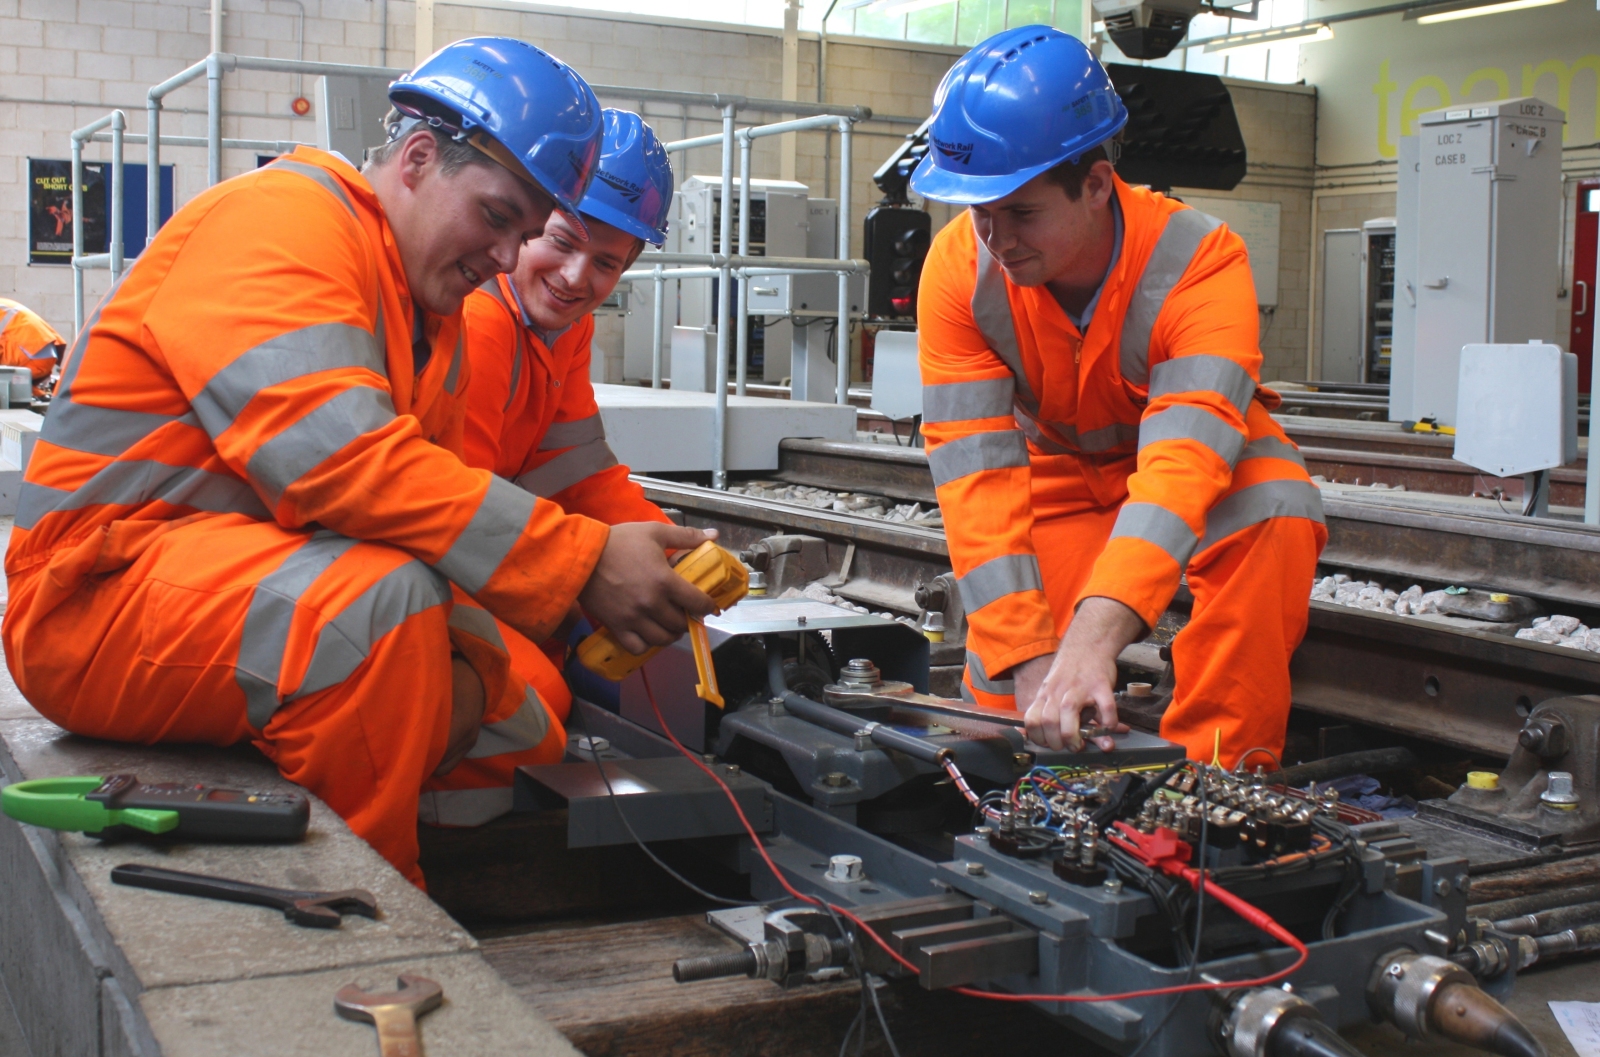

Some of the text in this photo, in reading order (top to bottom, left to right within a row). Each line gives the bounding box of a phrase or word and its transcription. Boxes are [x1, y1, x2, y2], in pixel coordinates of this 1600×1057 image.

[472, 59, 496, 73] SAFETY
[1520, 104, 1544, 117] LOC Z
[1541, 126, 1546, 138] B
[1437, 133, 1462, 146] LOC Z
[956, 143, 974, 151] Rail
[1435, 153, 1466, 166] CASE B
[35, 176, 67, 185] CUT OUT
[43, 183, 88, 192] SHORT CS
[629, 182, 646, 195] Rail
